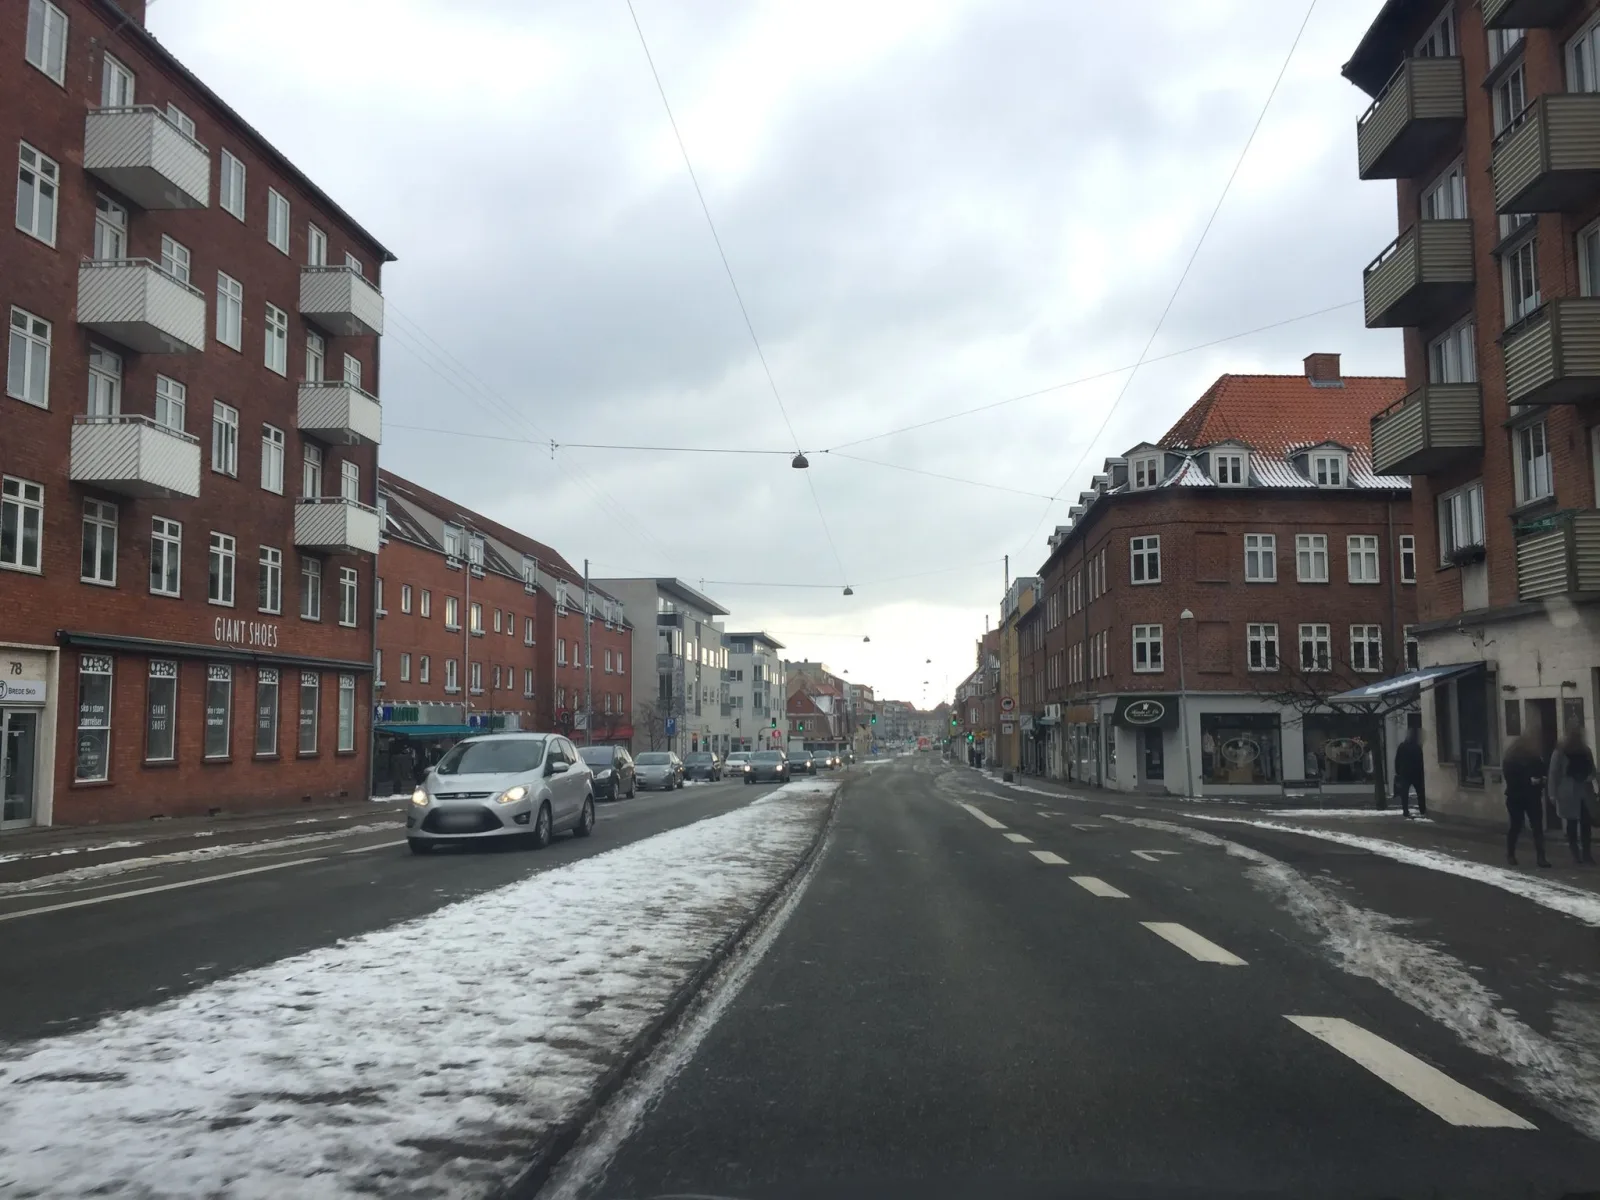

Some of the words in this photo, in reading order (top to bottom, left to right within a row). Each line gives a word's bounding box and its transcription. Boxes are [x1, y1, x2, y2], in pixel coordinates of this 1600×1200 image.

[214, 616, 246, 644] GIANT
[249, 621, 278, 648] SHOES
[9, 661, 22, 675] 78
[152, 704, 166, 715] GIANT
[151, 720, 166, 730] SHOES
[667, 719, 674, 728] P
